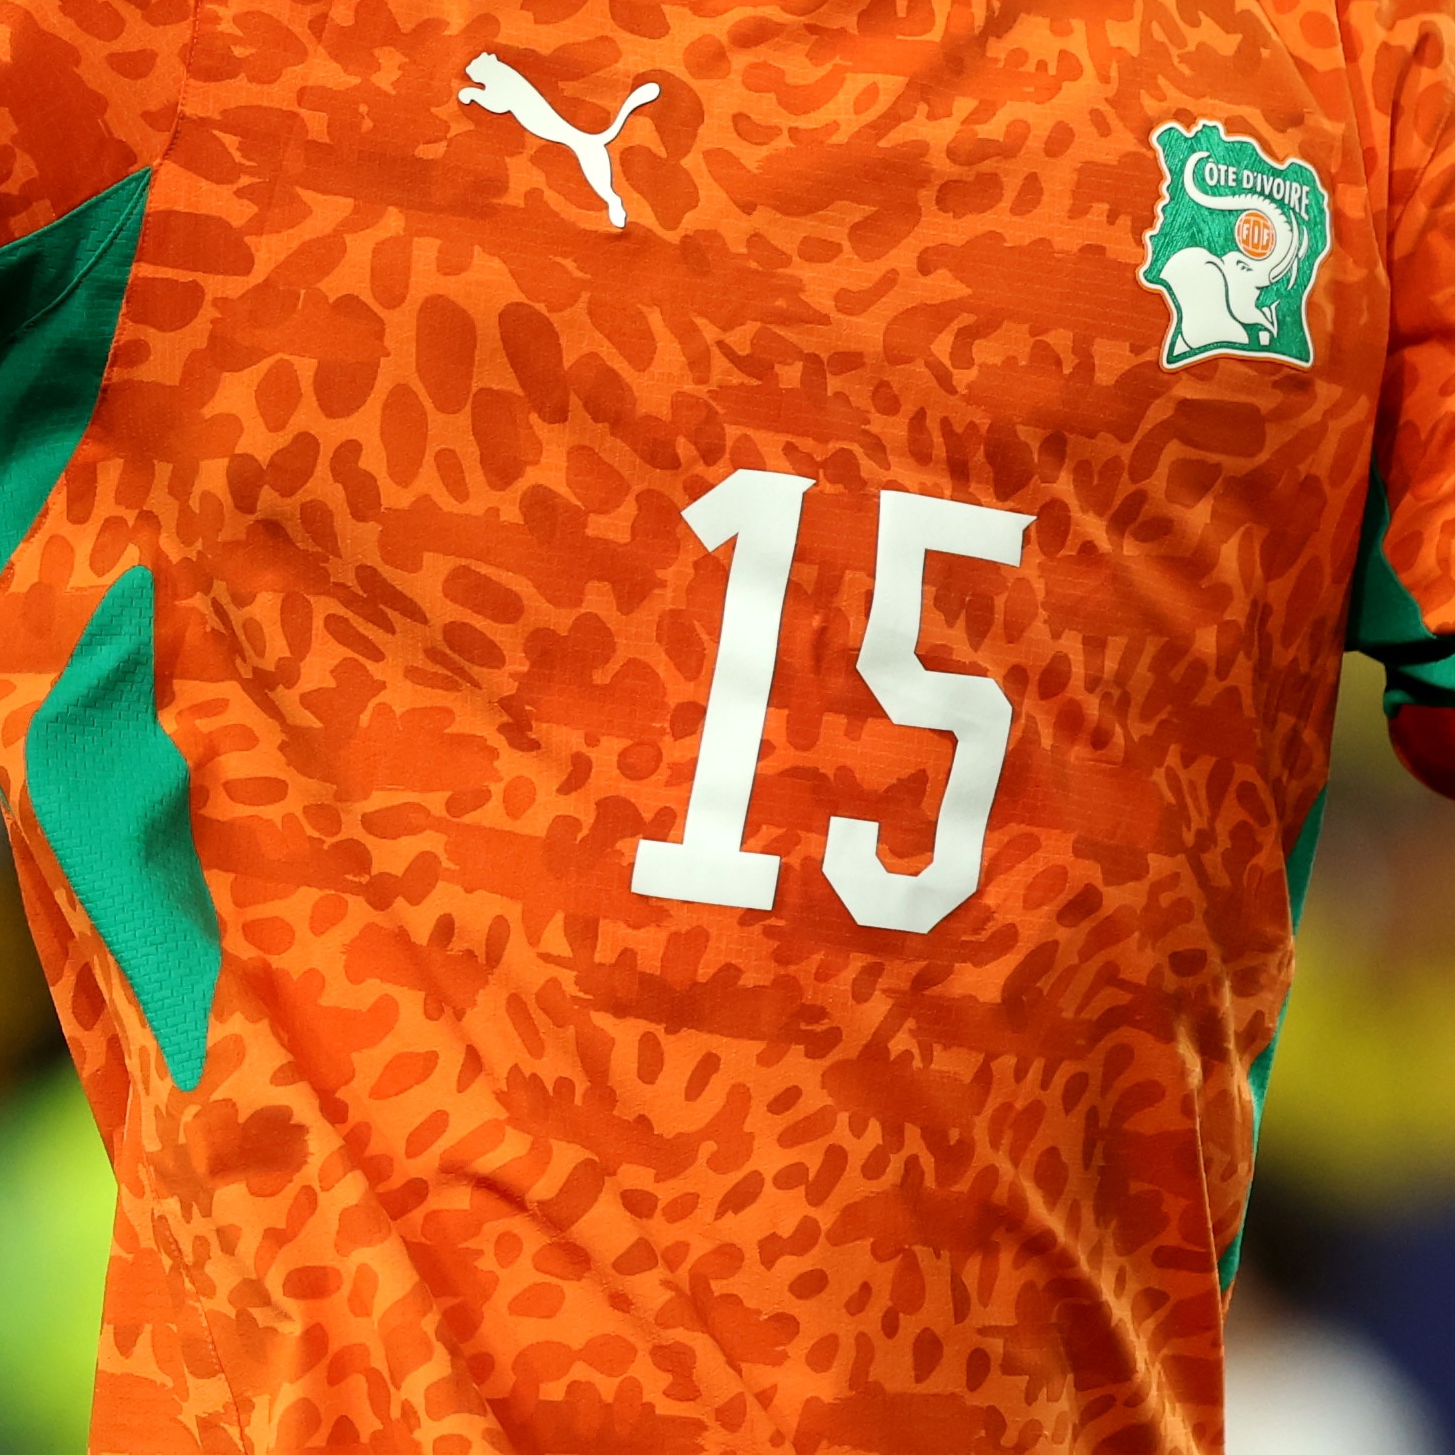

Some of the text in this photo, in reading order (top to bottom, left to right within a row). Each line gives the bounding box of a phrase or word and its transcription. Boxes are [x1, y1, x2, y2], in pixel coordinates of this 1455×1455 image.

[1243, 169, 1309, 221] D'IVOIRE
[1242, 223, 1270, 246] FIF
[630, 468, 1038, 934] 15
